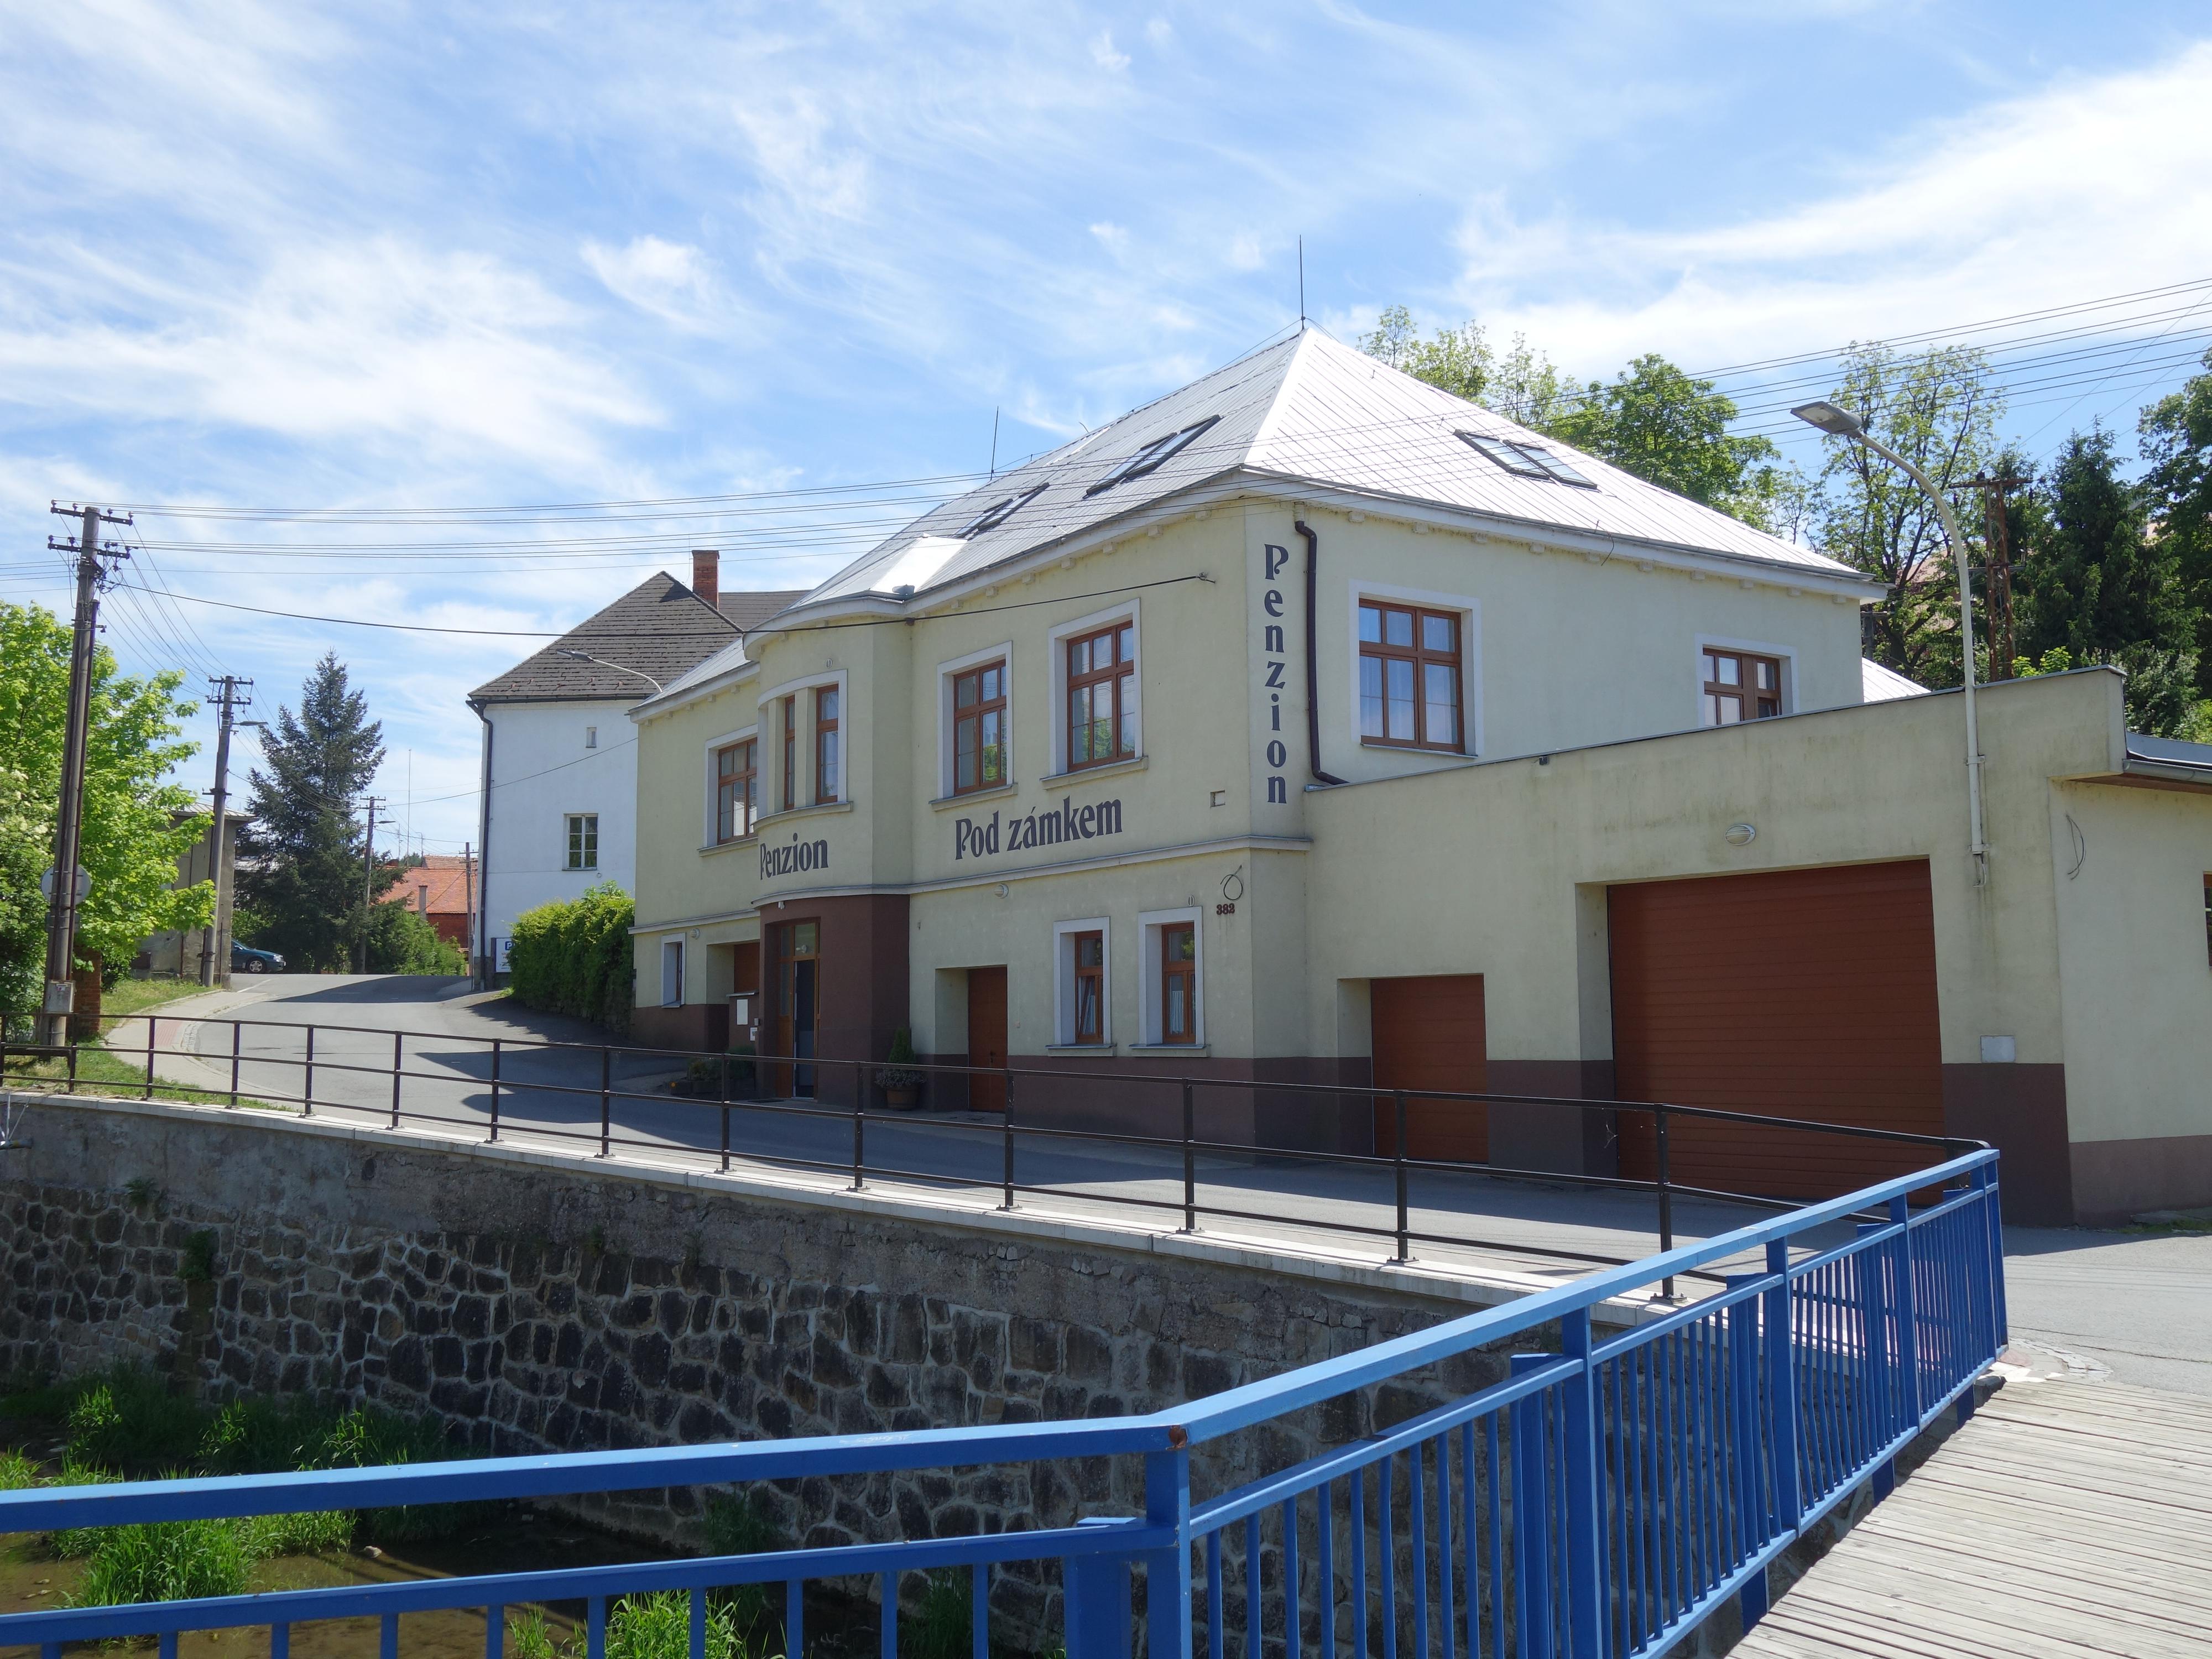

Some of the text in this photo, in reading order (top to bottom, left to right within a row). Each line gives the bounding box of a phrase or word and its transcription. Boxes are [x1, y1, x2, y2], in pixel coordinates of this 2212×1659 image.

[1264, 544, 1289, 804] Penzion
[955, 795, 1123, 860] Pod zámkem
[760, 832, 829, 880] Penzion
[1216, 903, 1235, 915] 382
